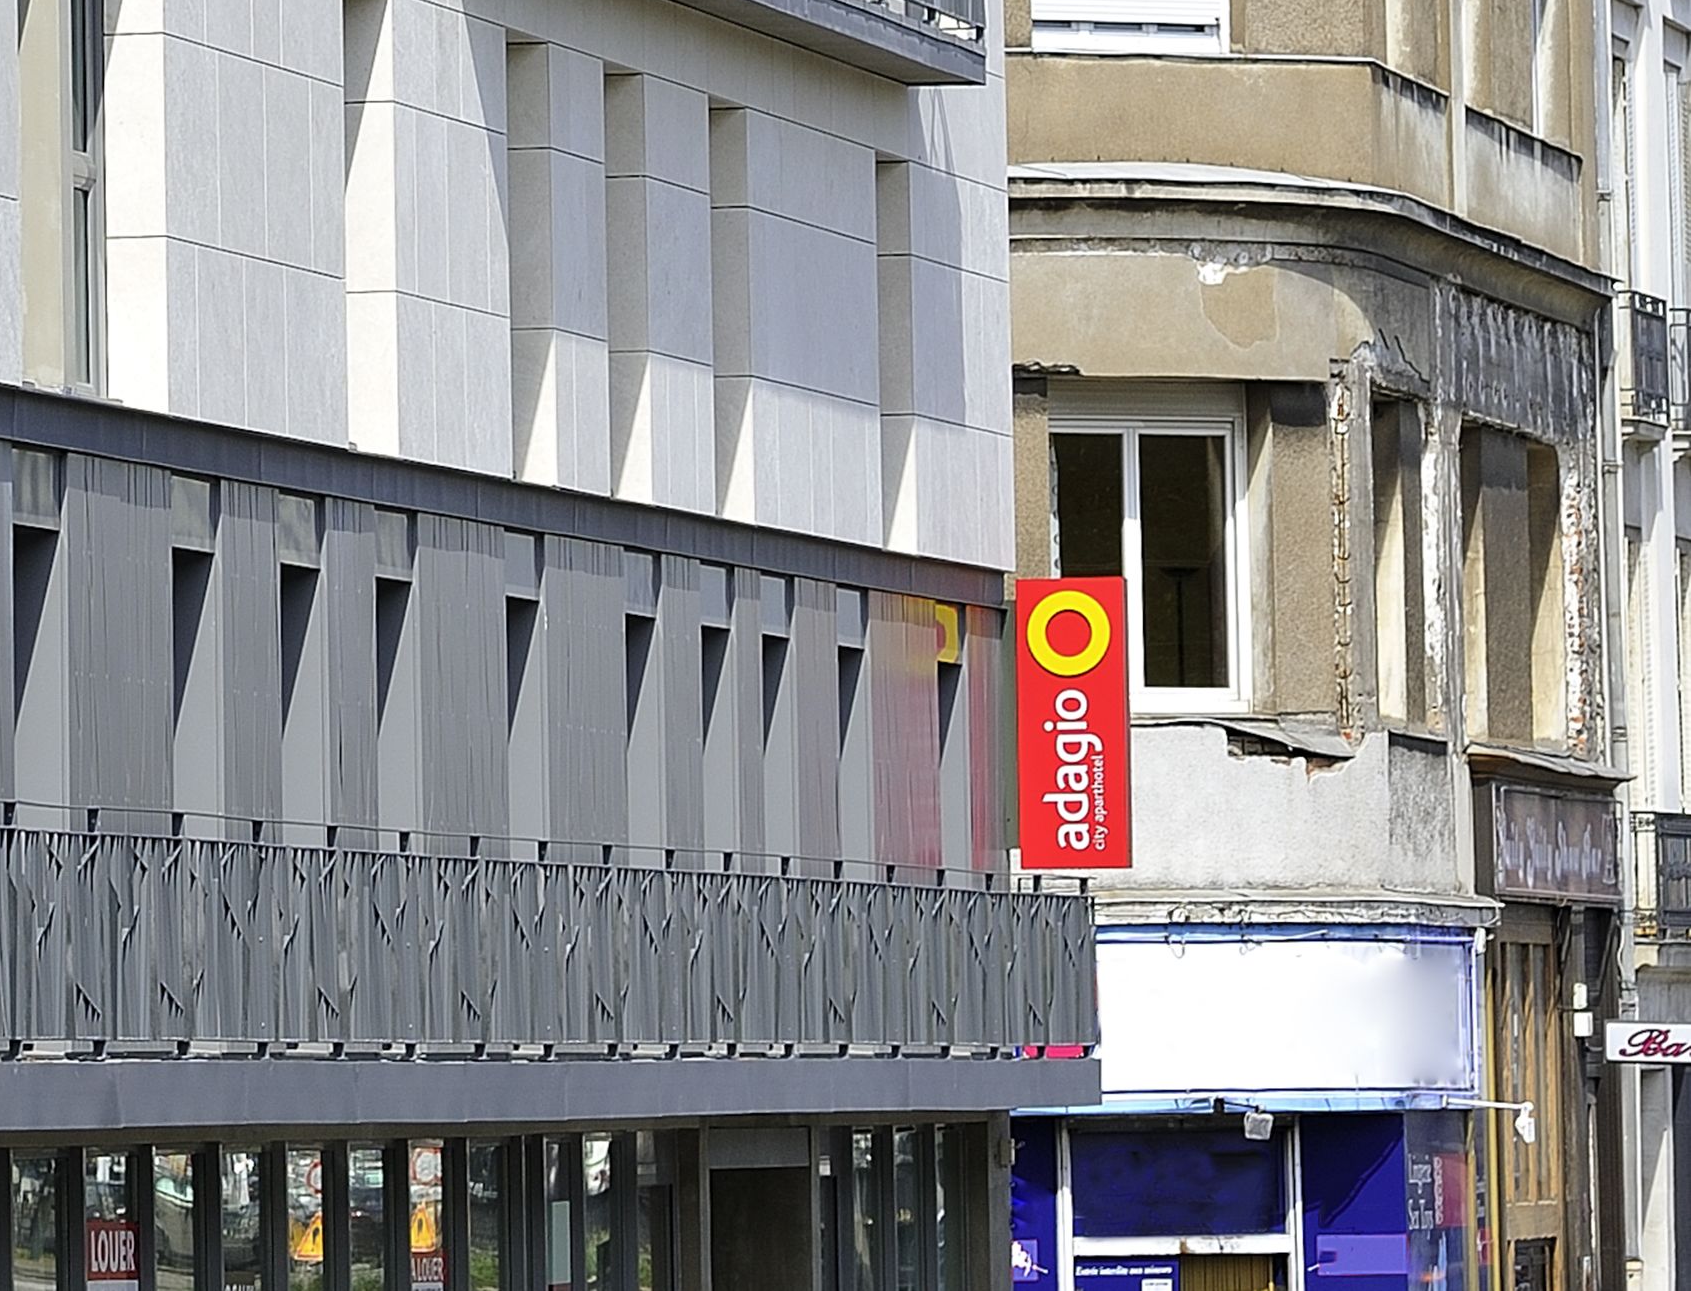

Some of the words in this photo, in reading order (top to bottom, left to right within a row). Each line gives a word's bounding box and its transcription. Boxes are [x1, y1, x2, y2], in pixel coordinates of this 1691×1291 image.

[1042, 688, 1104, 850] adagio
[1090, 754, 1109, 823] aparthotel
[1091, 825, 1109, 851] city
[1619, 1029, 1691, 1058] Ba
[90, 1229, 136, 1273] LOUER
